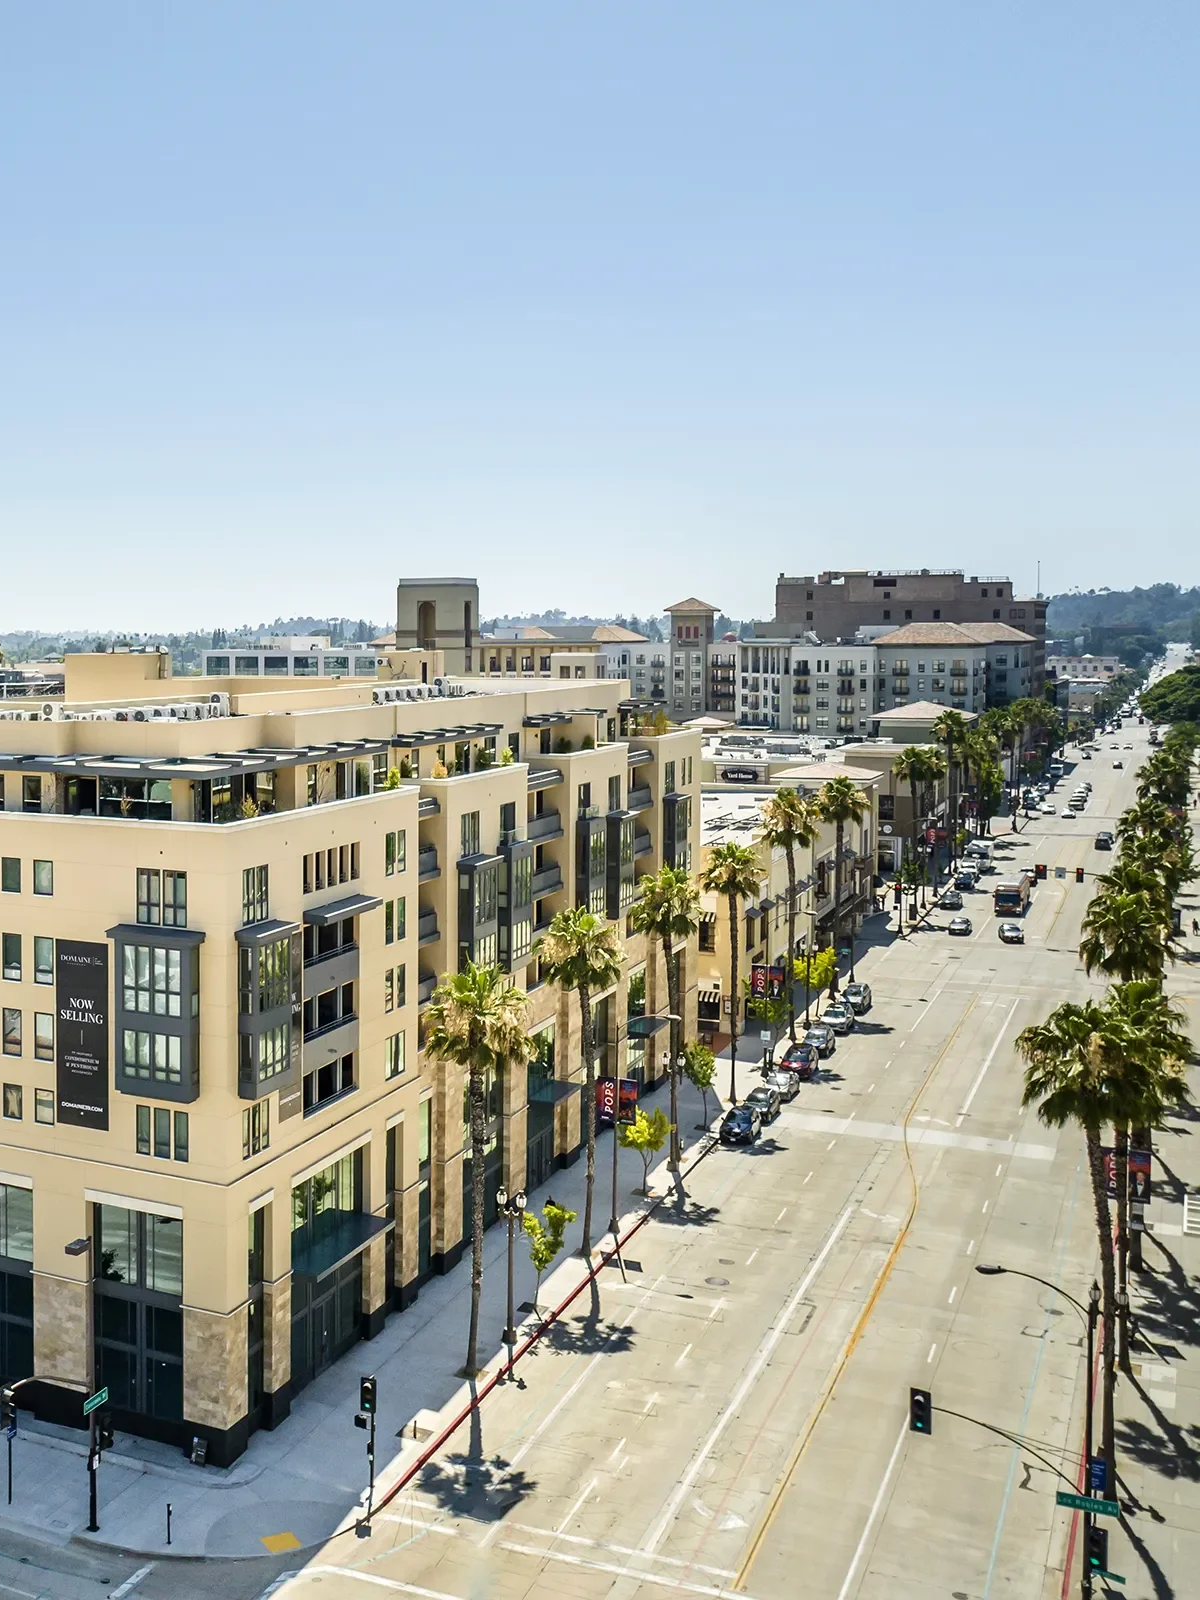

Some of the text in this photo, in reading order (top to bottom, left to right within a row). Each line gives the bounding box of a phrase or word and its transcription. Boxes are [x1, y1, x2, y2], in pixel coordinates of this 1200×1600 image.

[60, 954, 91, 964] DOMAINE
[757, 968, 765, 993] POPS
[70, 997, 94, 1010] NOW
[60, 1009, 103, 1025] SELLING
[604, 1081, 614, 1114] POPS
[1075, 1499, 1103, 1510] Robles
